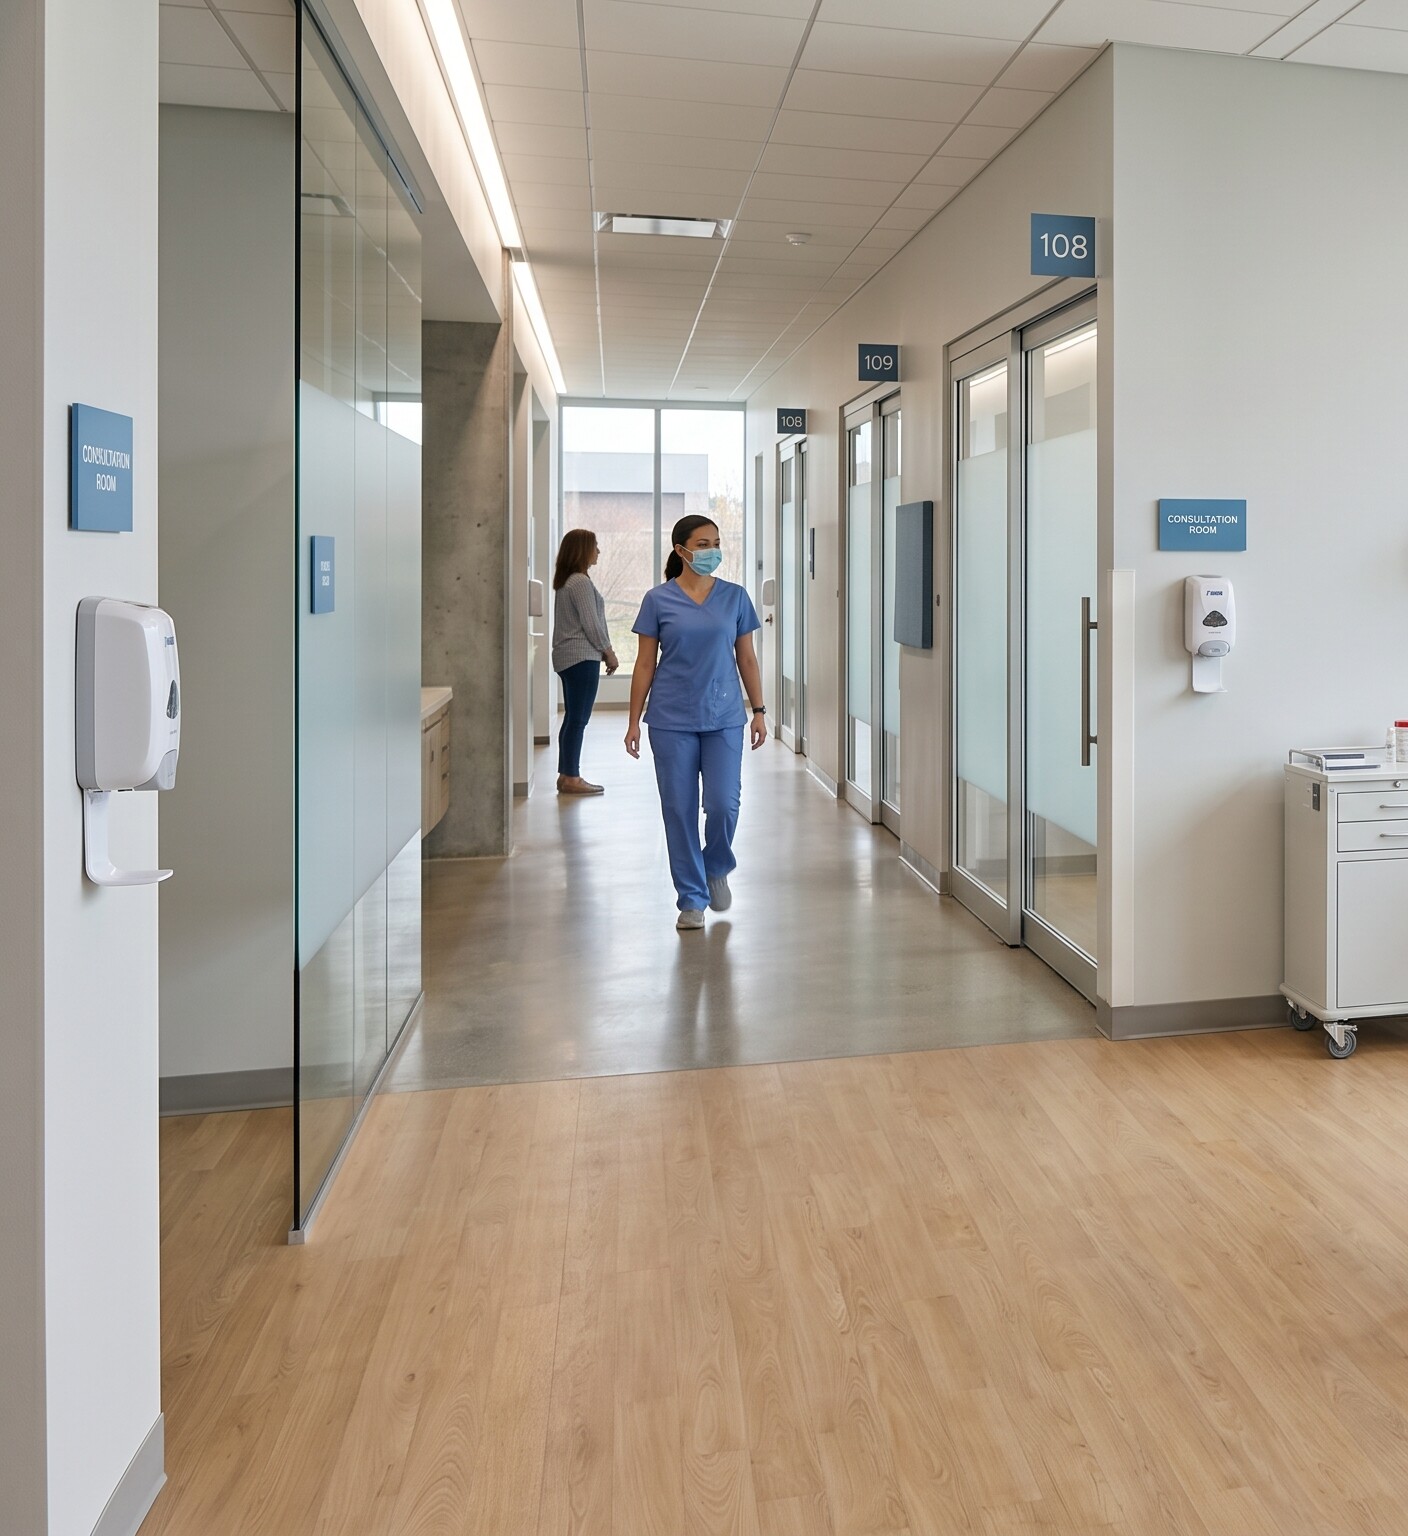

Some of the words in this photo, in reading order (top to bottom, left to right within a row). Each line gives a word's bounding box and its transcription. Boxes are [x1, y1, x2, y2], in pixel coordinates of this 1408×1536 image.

[1040, 233, 1088, 260] 108
[864, 355, 893, 371] 109
[781, 415, 802, 428] 108
[96, 473, 117, 492] ROOM
[1167, 514, 1238, 524] CONSULTATION
[1189, 525, 1217, 534] ROOM
